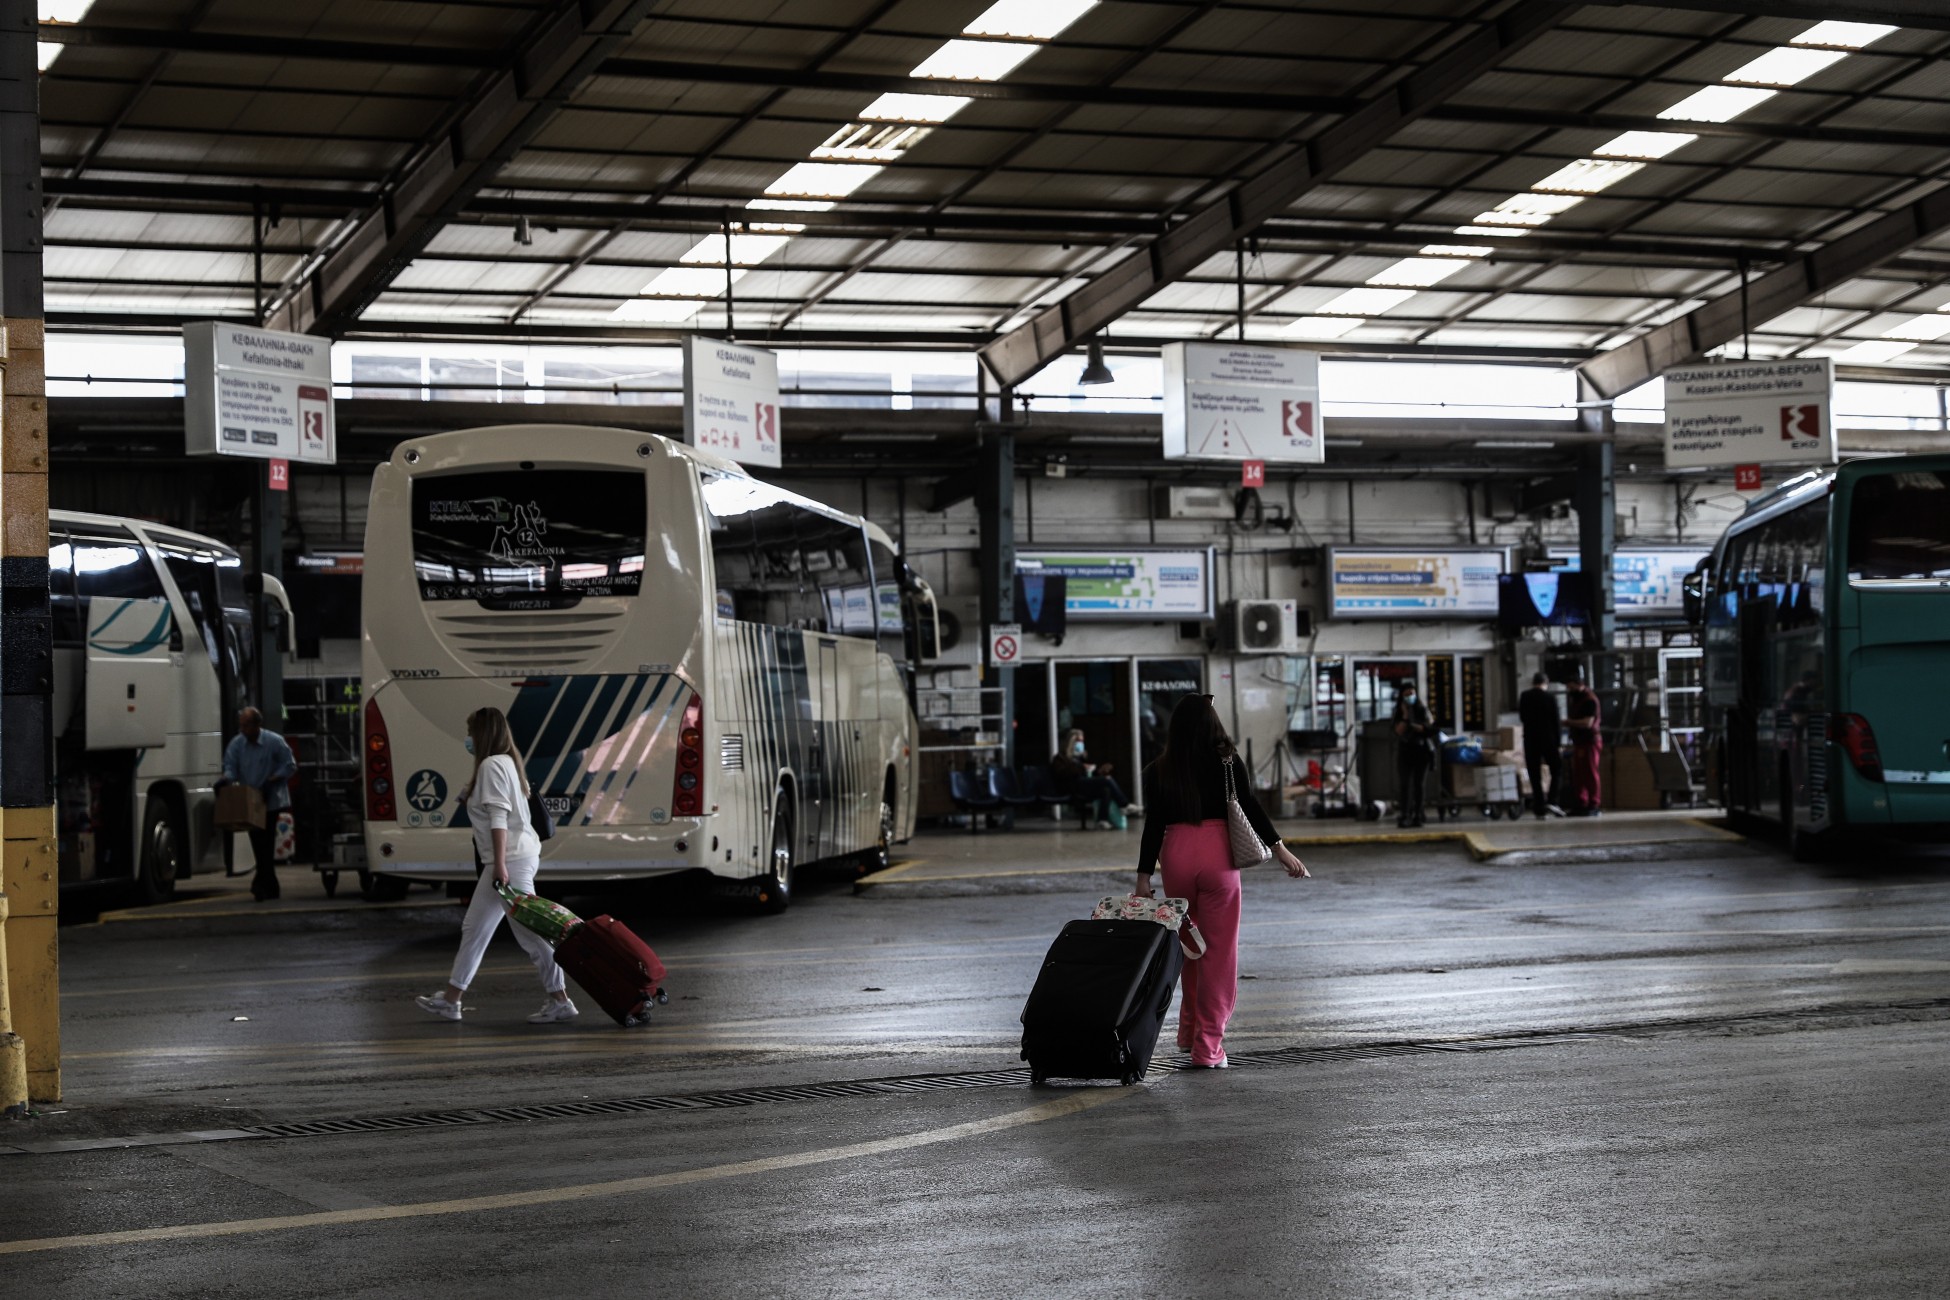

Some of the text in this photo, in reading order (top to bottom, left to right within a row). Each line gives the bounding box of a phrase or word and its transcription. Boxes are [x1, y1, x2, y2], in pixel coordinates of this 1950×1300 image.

[232, 333, 314, 355] ΚΕΦΑΛΛΗΝΙΑ-ΙΘΑΚΗ
[716, 349, 756, 366] ΚΕΦΑΛΛΗΝΙΑ
[1666, 363, 1822, 383] ΚΟΖΑΝΗ-ΚΑΣΤΟΡΙΑ-ΒΕΡΟΙΑ
[1686, 379, 1803, 394] Kozani-Kastoria-Veria
[272, 465, 286, 481] 12
[1247, 466, 1261, 479] 14
[1740, 471, 1757, 483] 15
[520, 531, 533, 542] 12
[514, 547, 565, 556] KEFALONIA
[298, 557, 335, 566] Panasonic
[391, 670, 440, 678] VOLVO
[545, 799, 568, 811] 980
